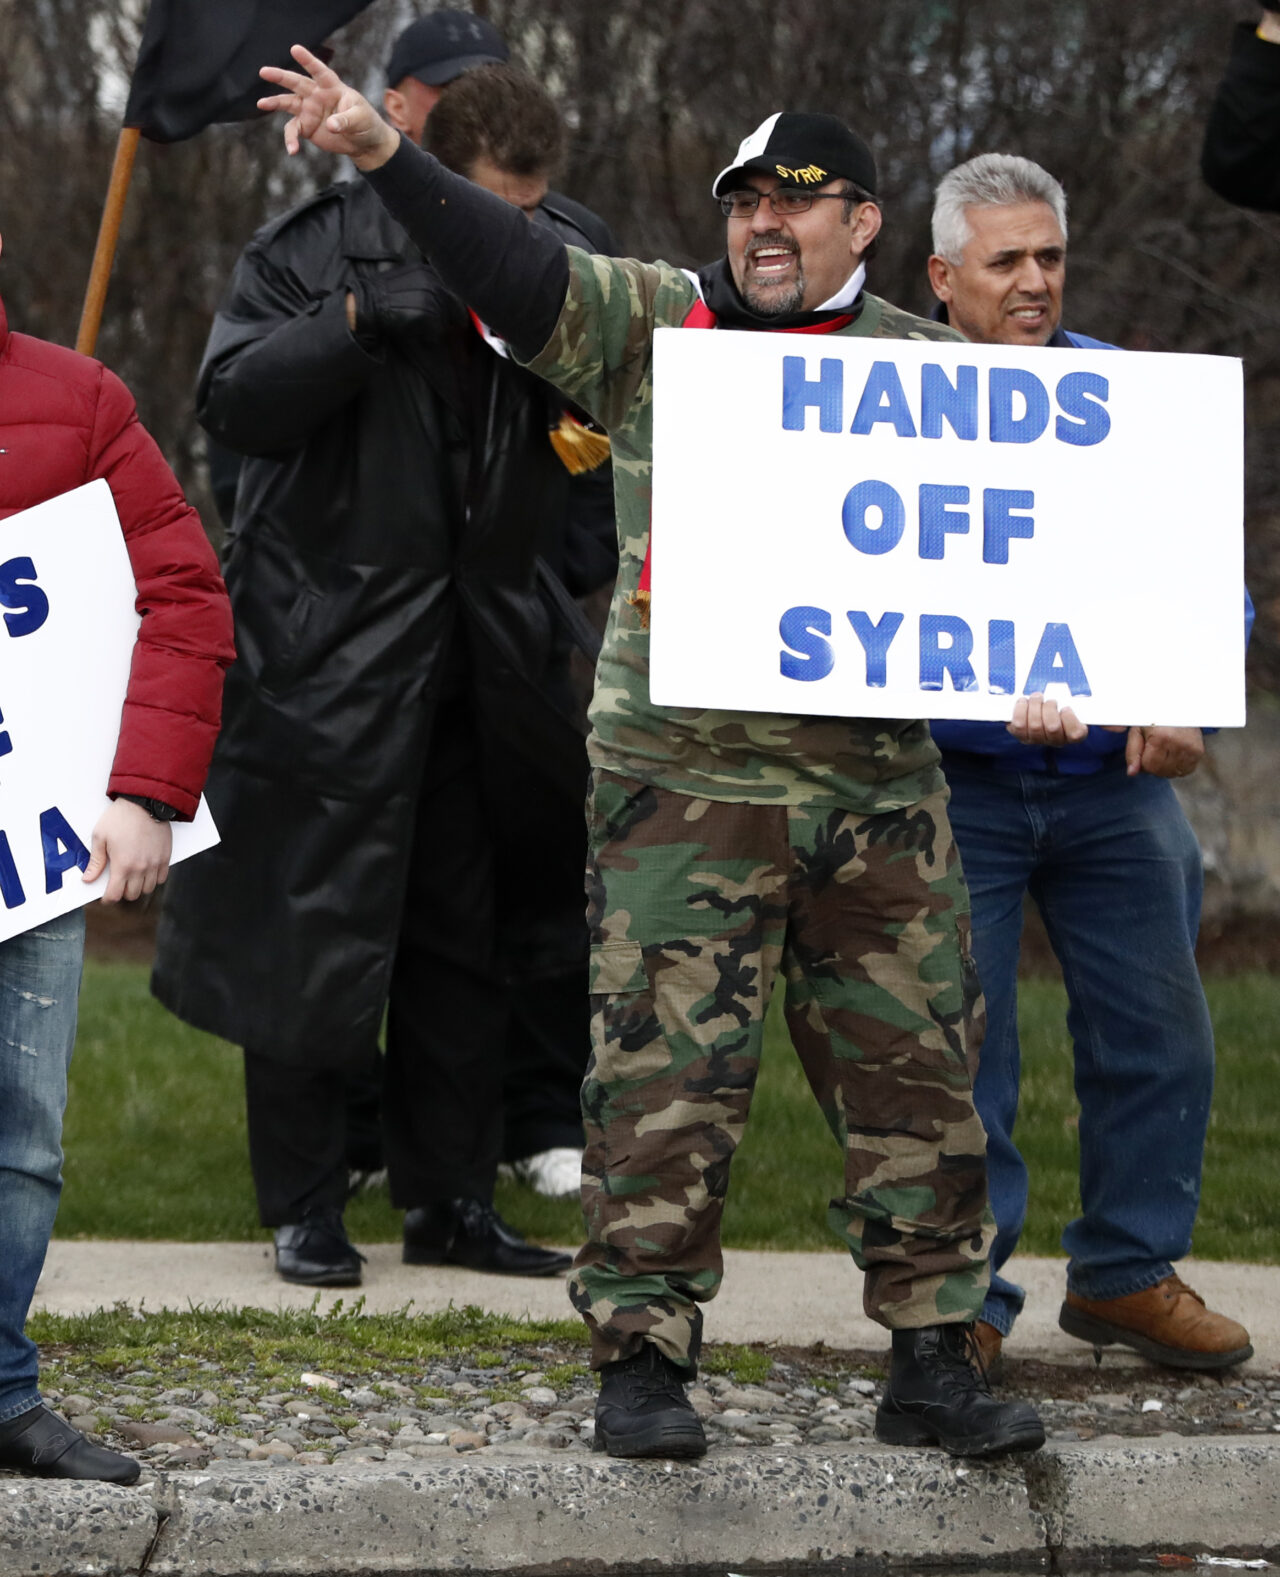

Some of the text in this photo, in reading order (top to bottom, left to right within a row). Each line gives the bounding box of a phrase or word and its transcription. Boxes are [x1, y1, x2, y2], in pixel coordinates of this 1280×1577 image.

[776, 164, 827, 184] SYRIA
[781, 355, 1112, 446] HANDS
[841, 479, 1035, 565] OFF
[779, 605, 1092, 697] SYRIA
